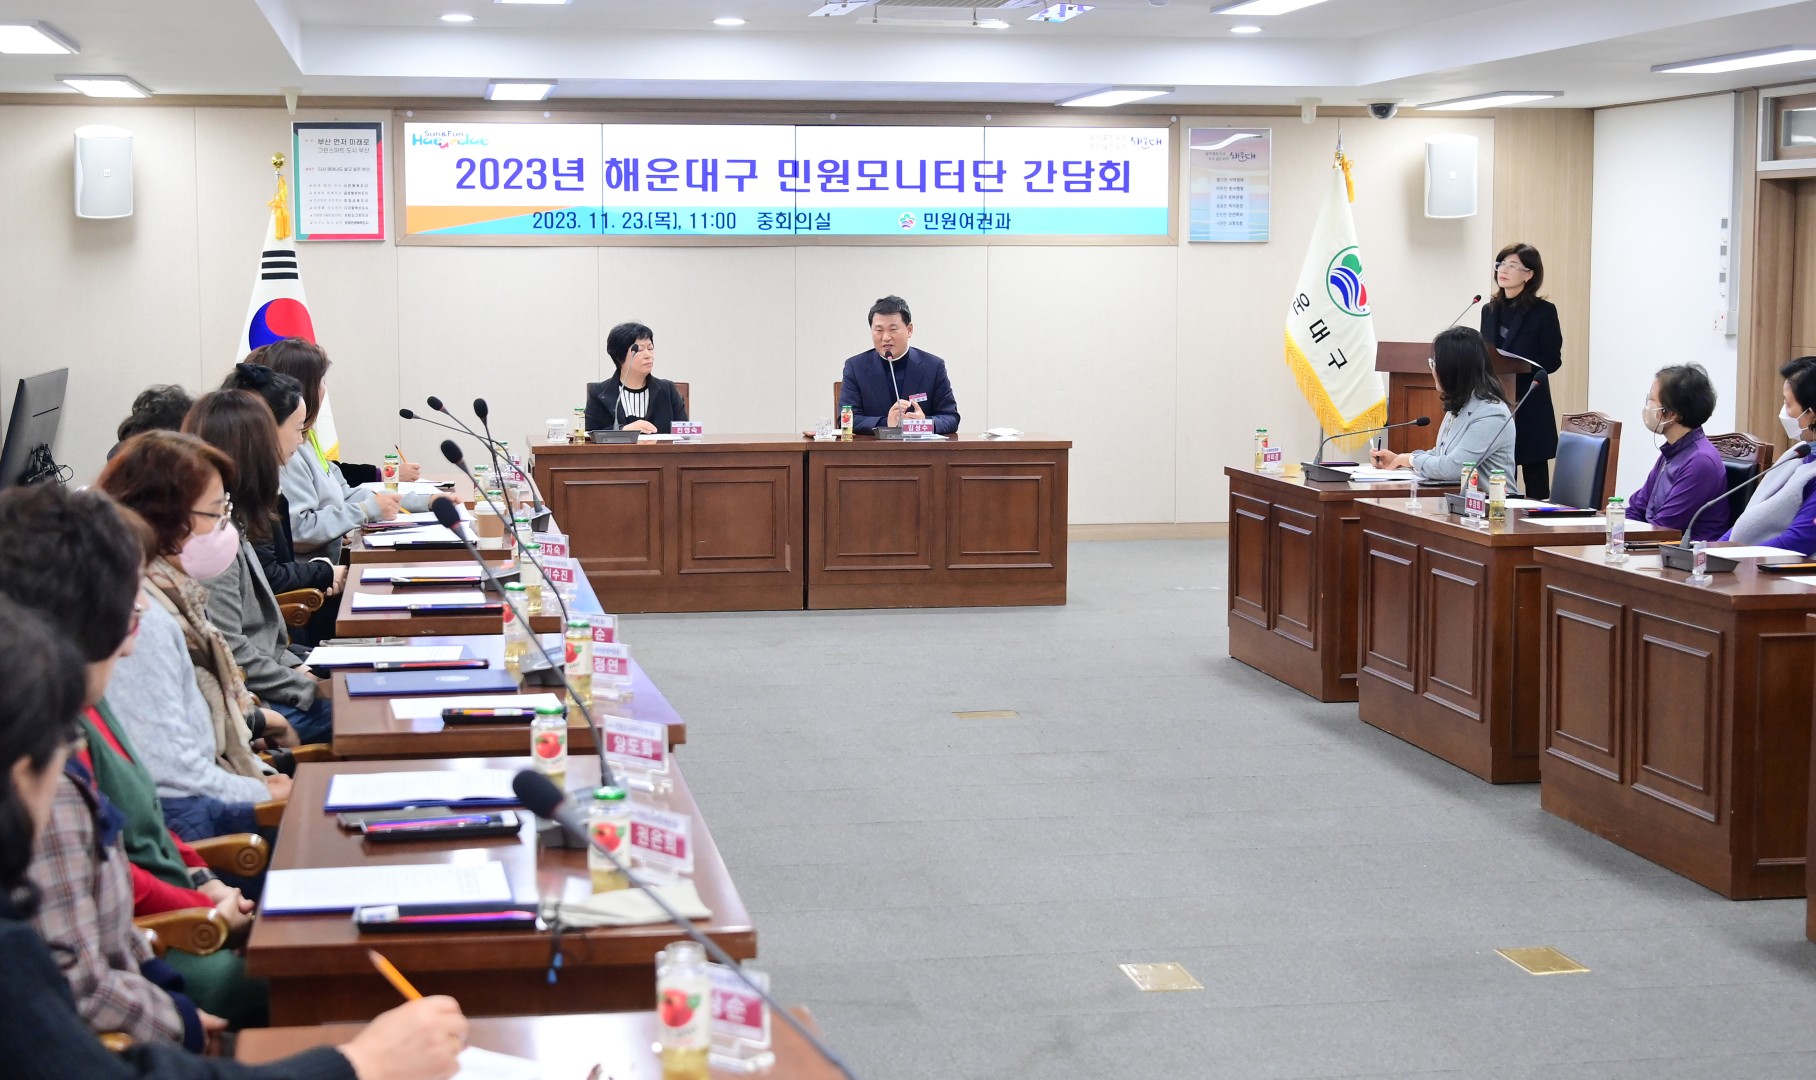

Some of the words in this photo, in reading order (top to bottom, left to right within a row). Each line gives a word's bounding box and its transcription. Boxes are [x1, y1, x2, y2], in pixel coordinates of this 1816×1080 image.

[333, 138, 347, 146] 먼저
[349, 138, 370, 146] 미래로
[455, 157, 585, 192] 2023년
[604, 157, 759, 193] 해운대구
[778, 159, 1007, 193] 민원모니터단
[1023, 159, 1130, 194] 간담회
[532, 211, 583, 229] 2023.
[589, 212, 615, 229] 11.
[690, 212, 736, 230] 11:00
[758, 211, 831, 231] 중회의실
[924, 212, 1011, 231] 민원여권과
[593, 657, 619, 674] 정연
[711, 989, 747, 1022] 순
